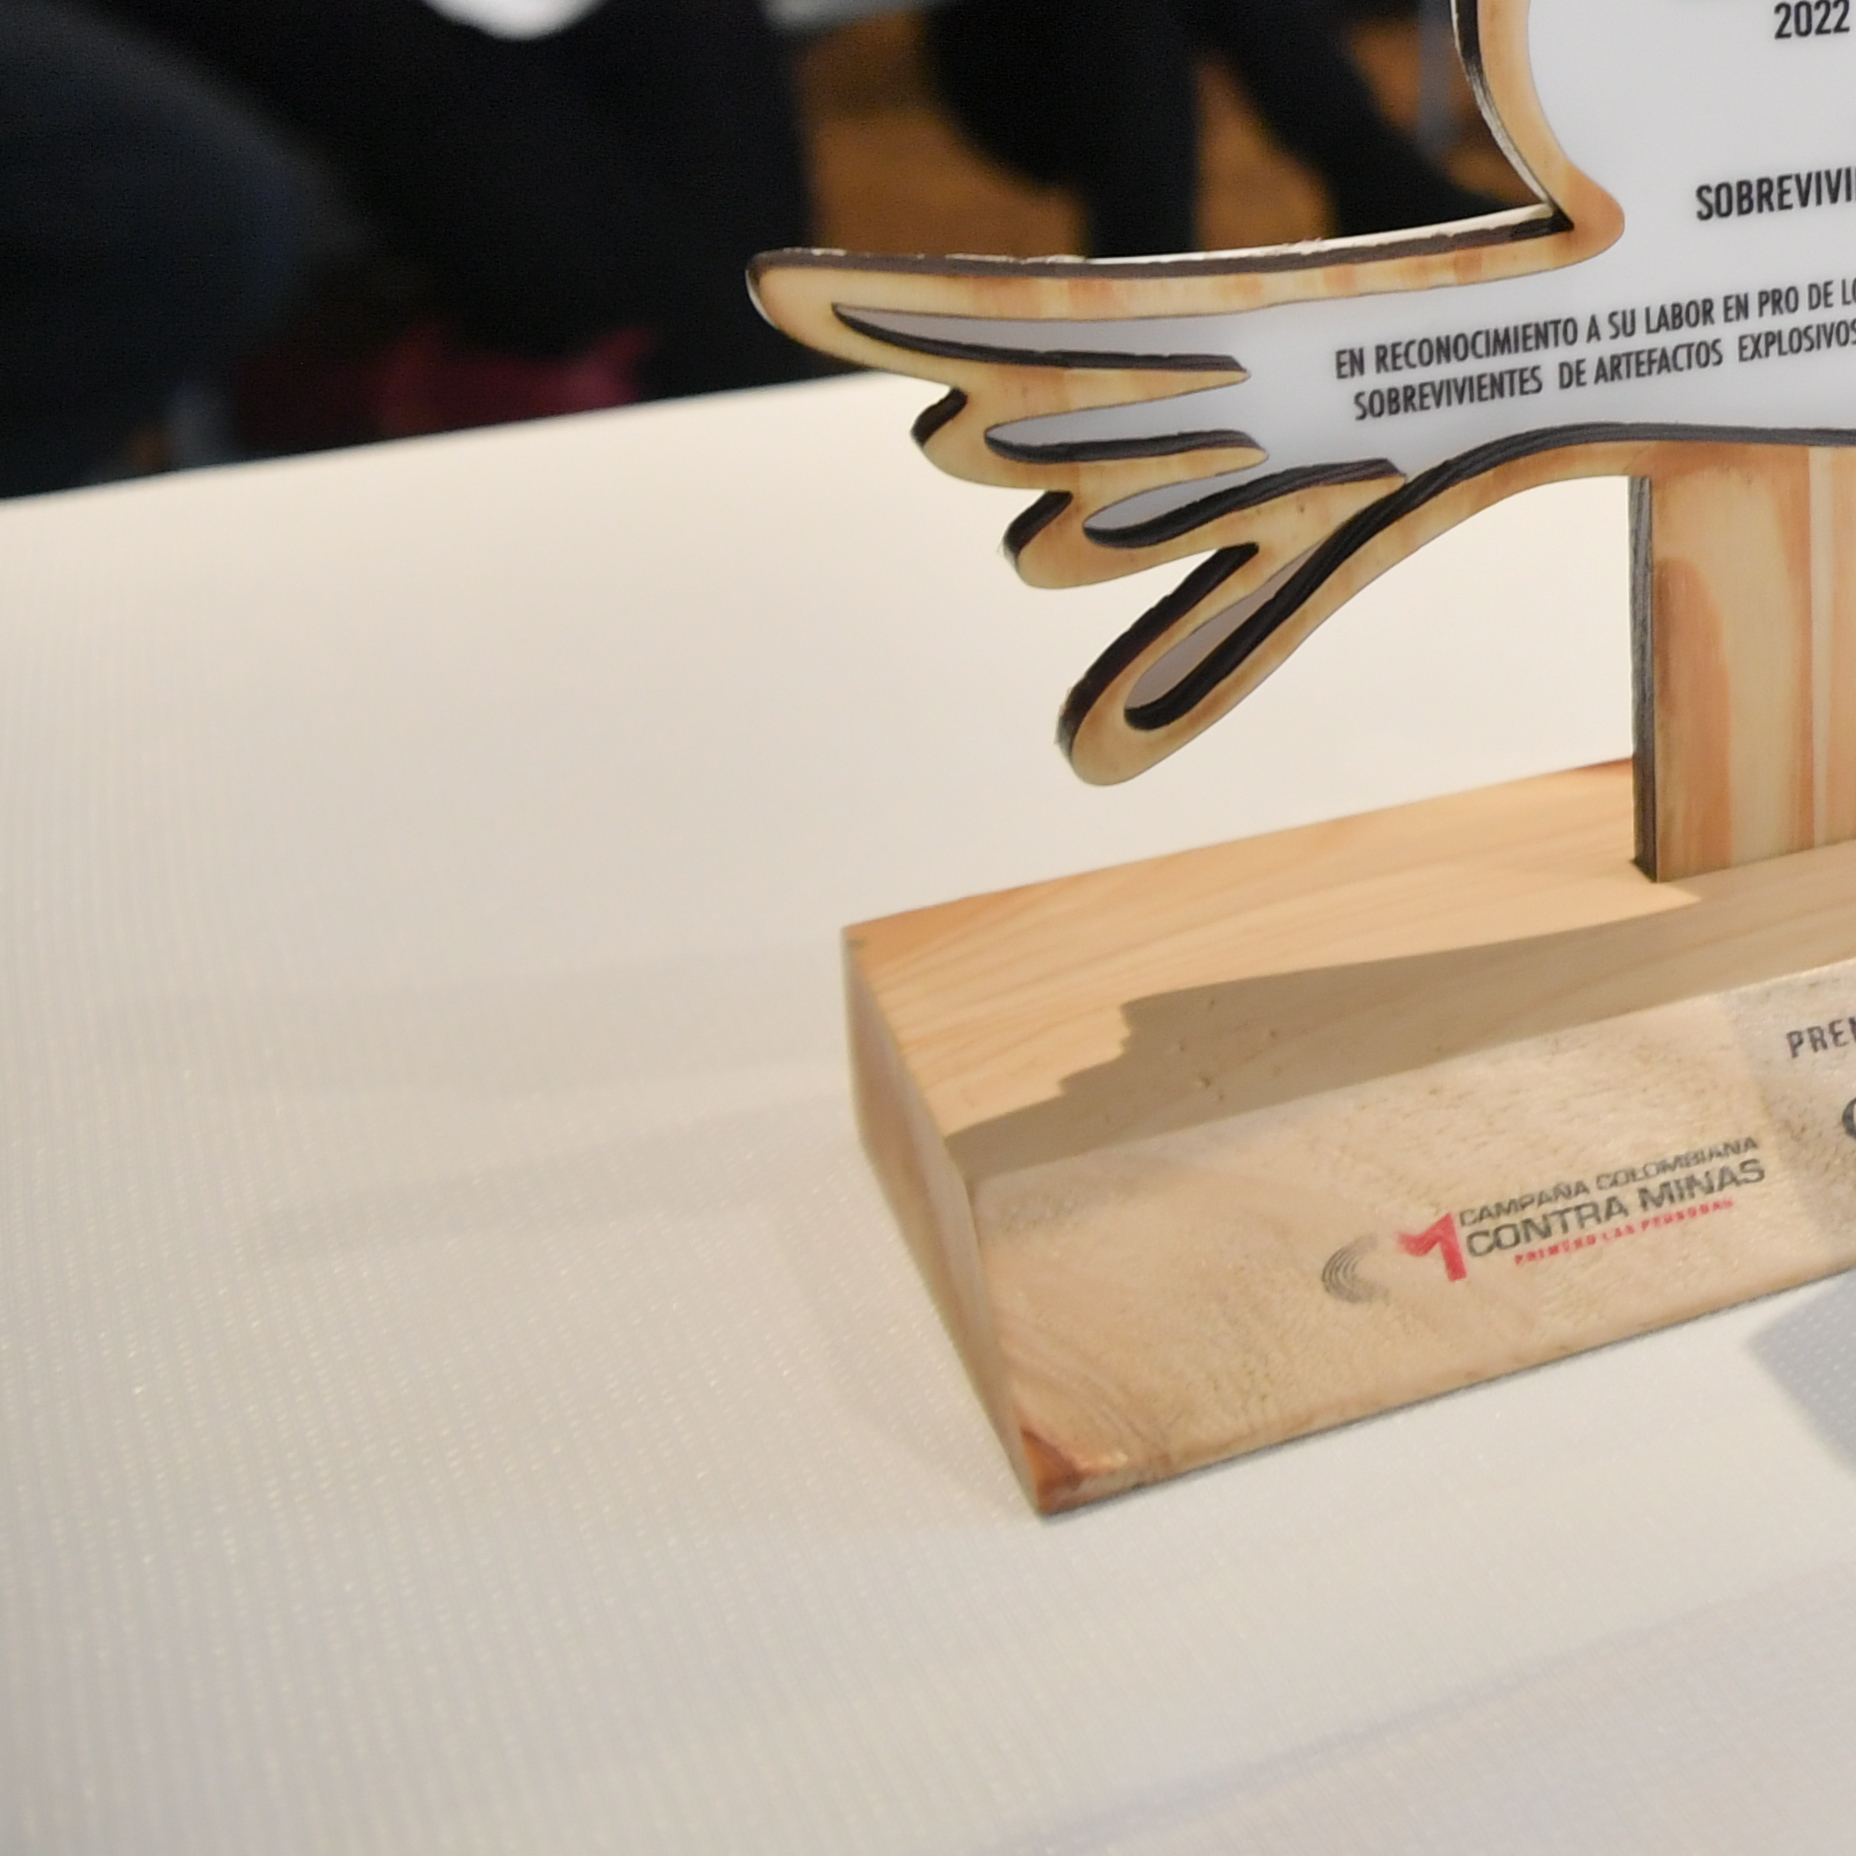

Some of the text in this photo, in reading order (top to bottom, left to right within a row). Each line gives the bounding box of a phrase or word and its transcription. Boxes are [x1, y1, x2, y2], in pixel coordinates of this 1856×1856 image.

[1336, 348, 1365, 380] EN
[1375, 317, 1578, 374] RECONOCIMIENTO
[1586, 314, 1601, 342] A
[1608, 309, 1636, 340] SU
[1645, 298, 1714, 333] LABOR
[1723, 292, 1749, 323] EN
[1758, 286, 1800, 318] PRO
[1808, 280, 1834, 311] DE
[1354, 365, 1542, 421] SOBREVIVIENTES
[1559, 359, 1587, 390] DE
[1594, 339, 1723, 386] ARTEFACTOS
[1459, 1136, 1759, 1226] CAMPAÑA COLOMBIANA
[1467, 1158, 1765, 1257] CONTRA MINAS
